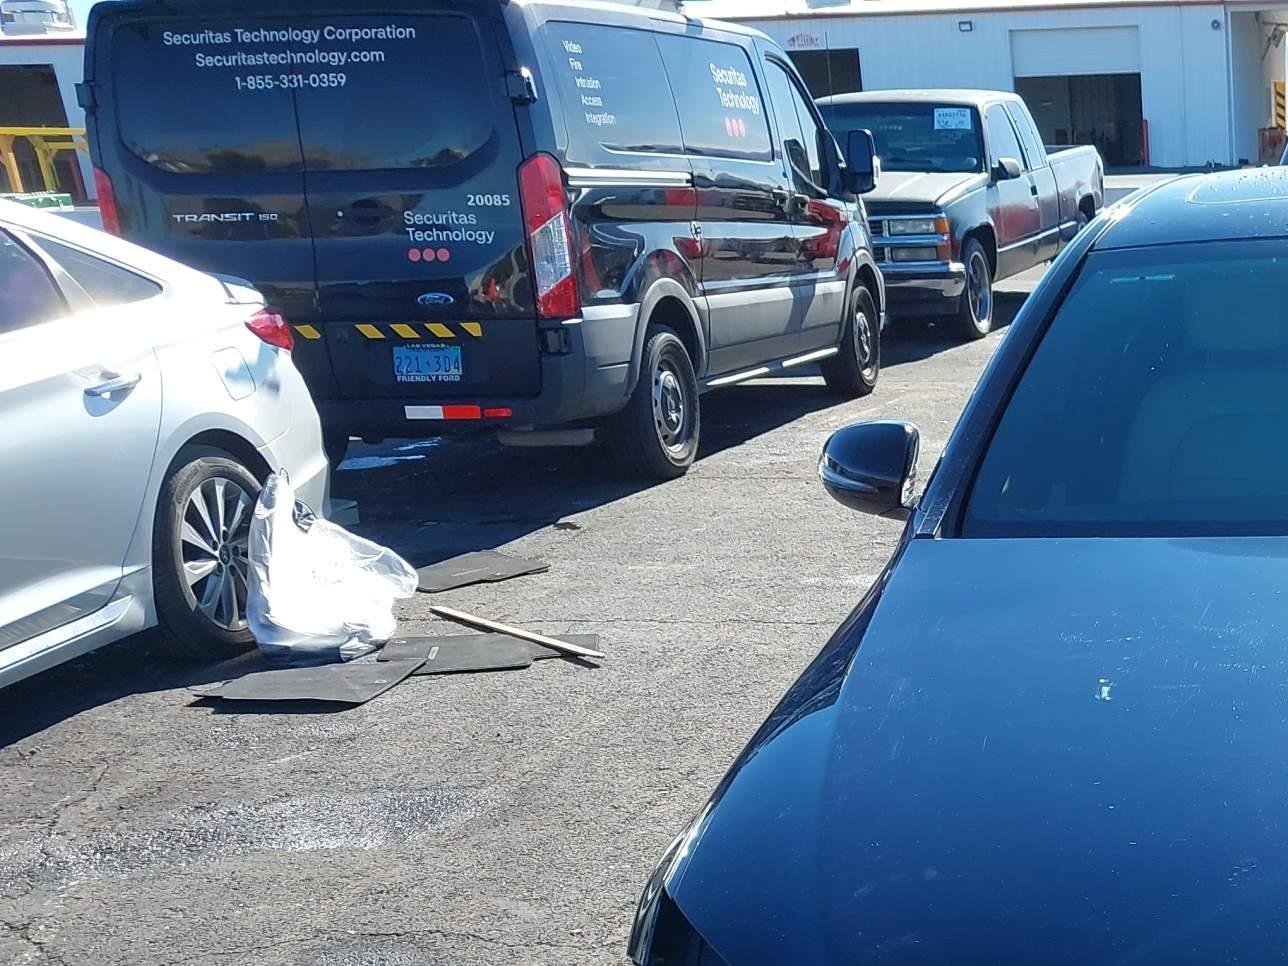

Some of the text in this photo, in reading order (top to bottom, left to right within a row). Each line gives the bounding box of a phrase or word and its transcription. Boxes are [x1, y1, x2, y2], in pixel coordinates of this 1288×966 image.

[163, 25, 416, 45] Securitas Technology Corporation
[562, 40, 583, 54] Video
[195, 49, 385, 67] Securitastechnology.com
[568, 57, 583, 71] Fire
[235, 73, 346, 90] 1-855-331-0359
[710, 62, 747, 87] Securitas
[575, 76, 602, 89] Intrusion
[581, 94, 603, 107] Access
[716, 87, 760, 115] Technology
[585, 111, 617, 126] Integration
[467, 194, 511, 206] 20085
[172, 212, 278, 223] TRANSIT 150
[403, 210, 477, 225] Securitas
[405, 227, 495, 245] Technology
[397, 375, 437, 383] FRIENDLY
